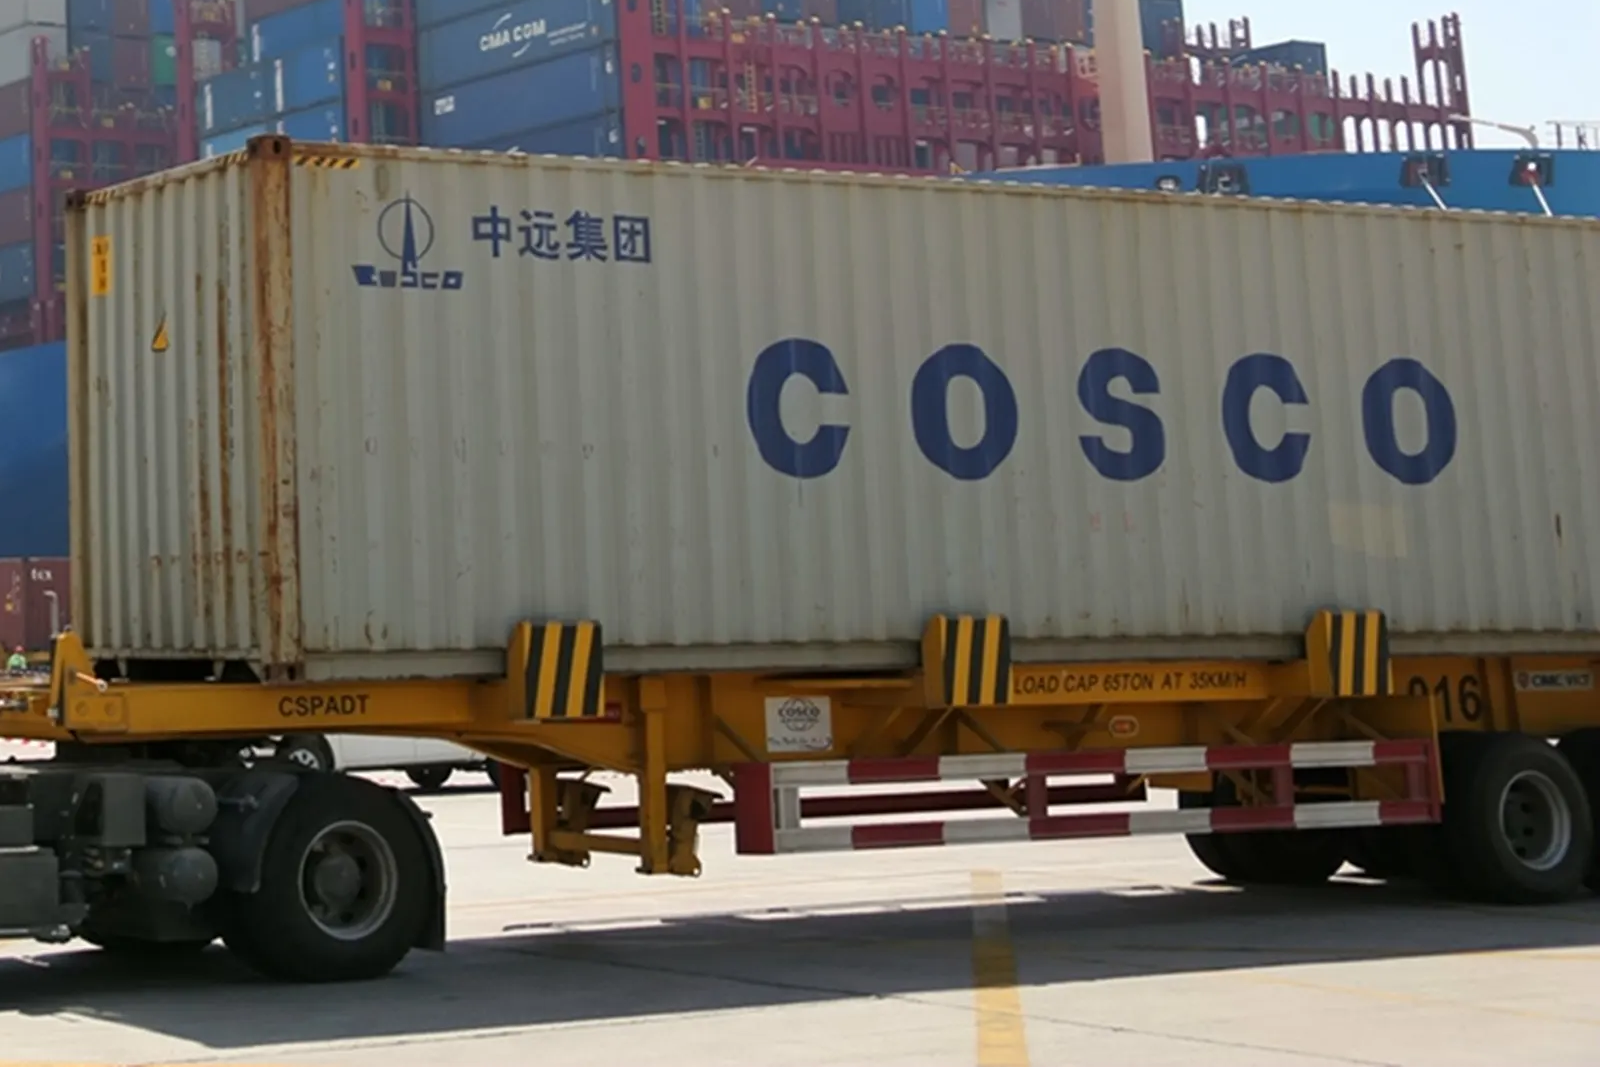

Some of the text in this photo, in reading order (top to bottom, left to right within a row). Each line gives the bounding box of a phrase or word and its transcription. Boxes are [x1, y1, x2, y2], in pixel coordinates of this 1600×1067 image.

[479, 32, 511, 52] CMA
[512, 19, 547, 43] CGM
[472, 205, 652, 264] 中远集团
[747, 337, 1457, 485] COSCO
[1013, 674, 1060, 695] LOAD
[1063, 673, 1099, 693] CAP
[1103, 671, 1154, 693] 65TON
[1160, 671, 1184, 690] AT
[278, 693, 370, 718] CSPADT
